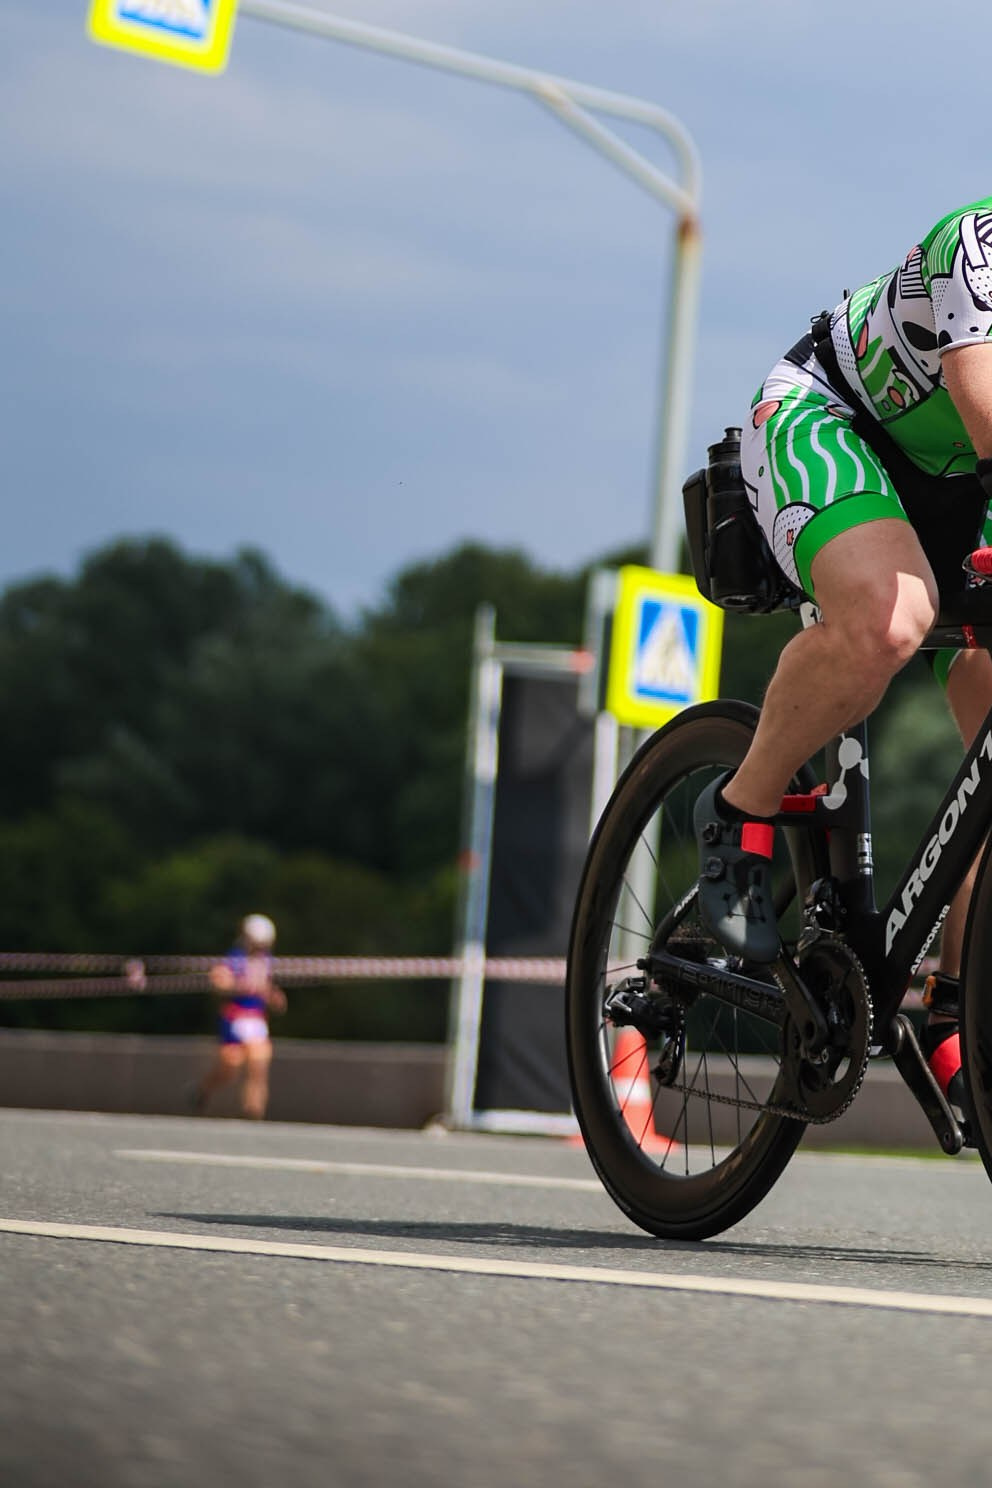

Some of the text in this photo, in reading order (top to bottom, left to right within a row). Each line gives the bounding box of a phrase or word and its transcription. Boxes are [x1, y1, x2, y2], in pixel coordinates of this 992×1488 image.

[885, 757, 981, 958] ARGON
[910, 904, 951, 975] ARGON 18
